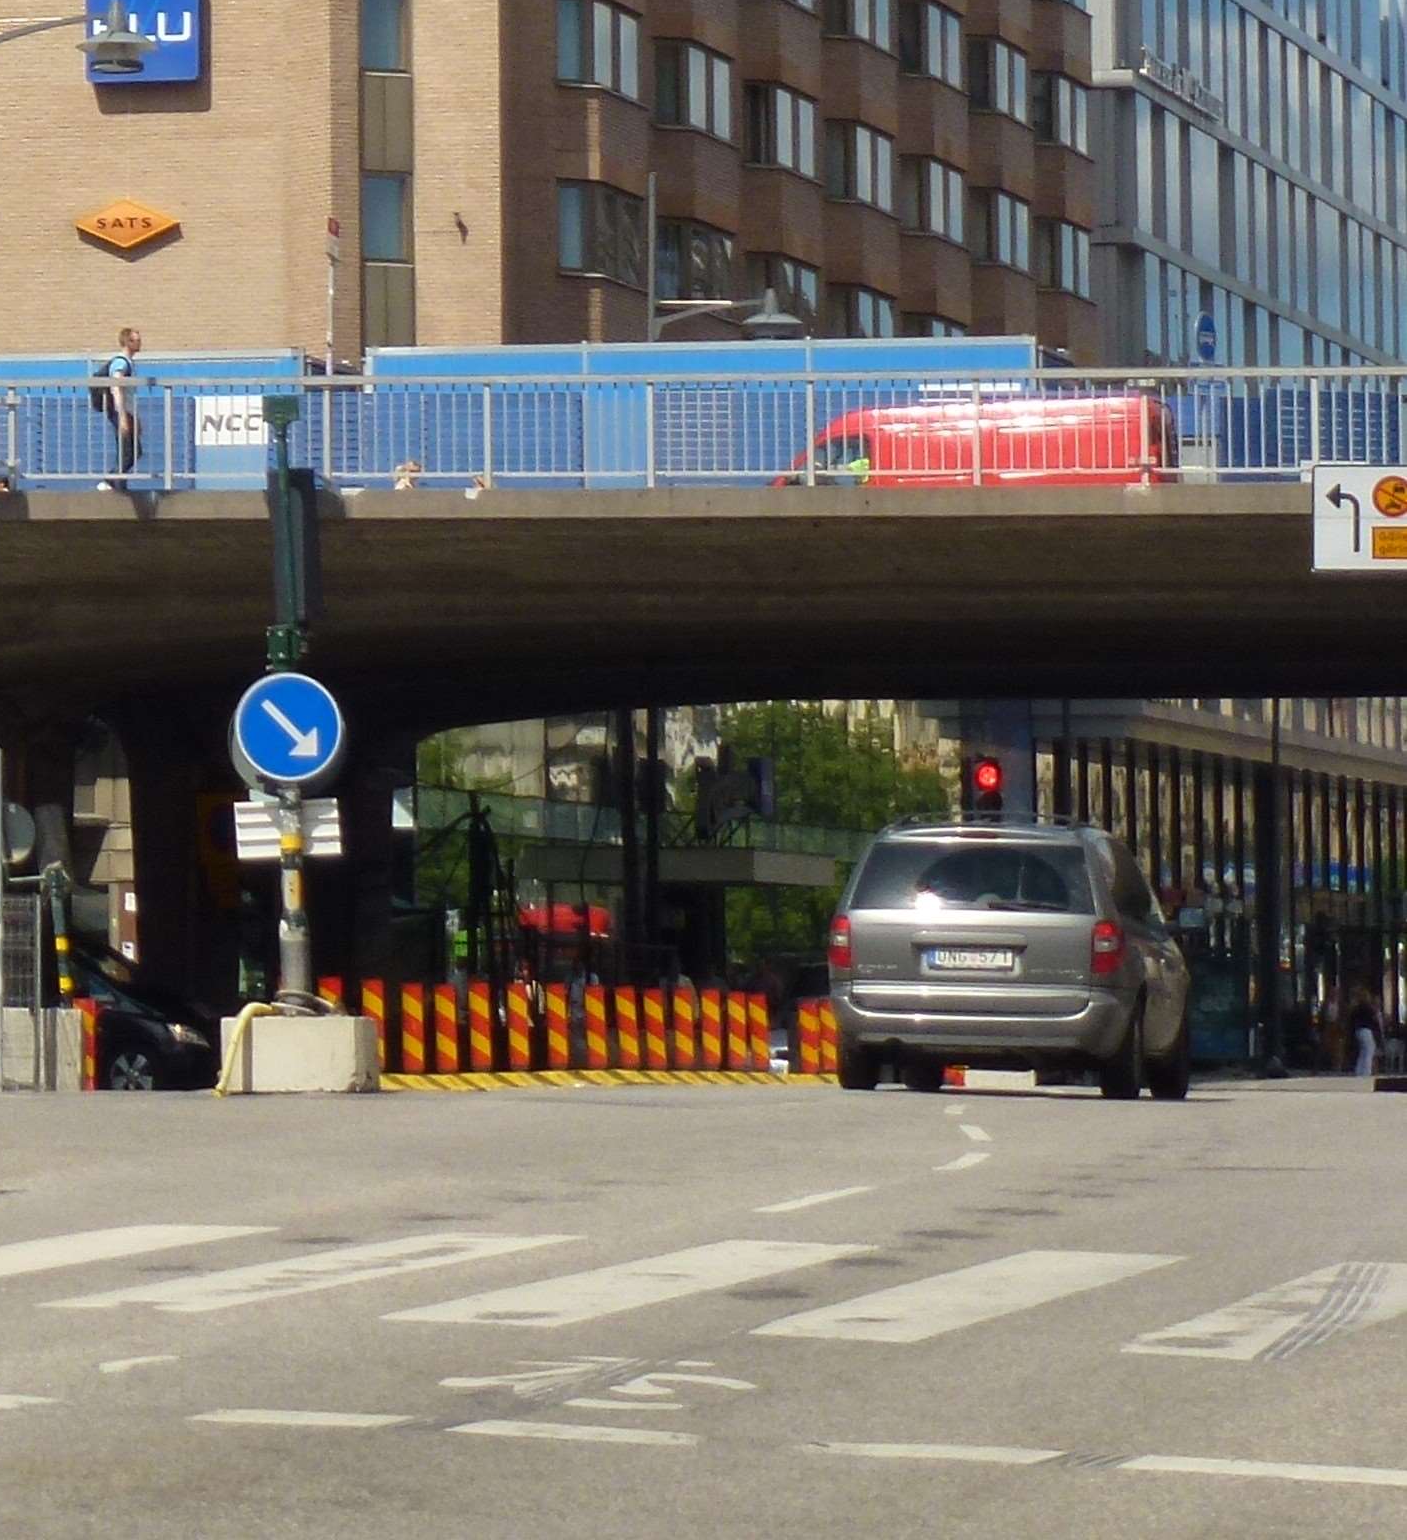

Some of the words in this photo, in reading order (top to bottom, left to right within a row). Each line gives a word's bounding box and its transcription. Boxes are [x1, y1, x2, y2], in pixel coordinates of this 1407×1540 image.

[93, 12, 191, 42] LU
[96, 217, 152, 230] SATS
[202, 413, 262, 432] NCC
